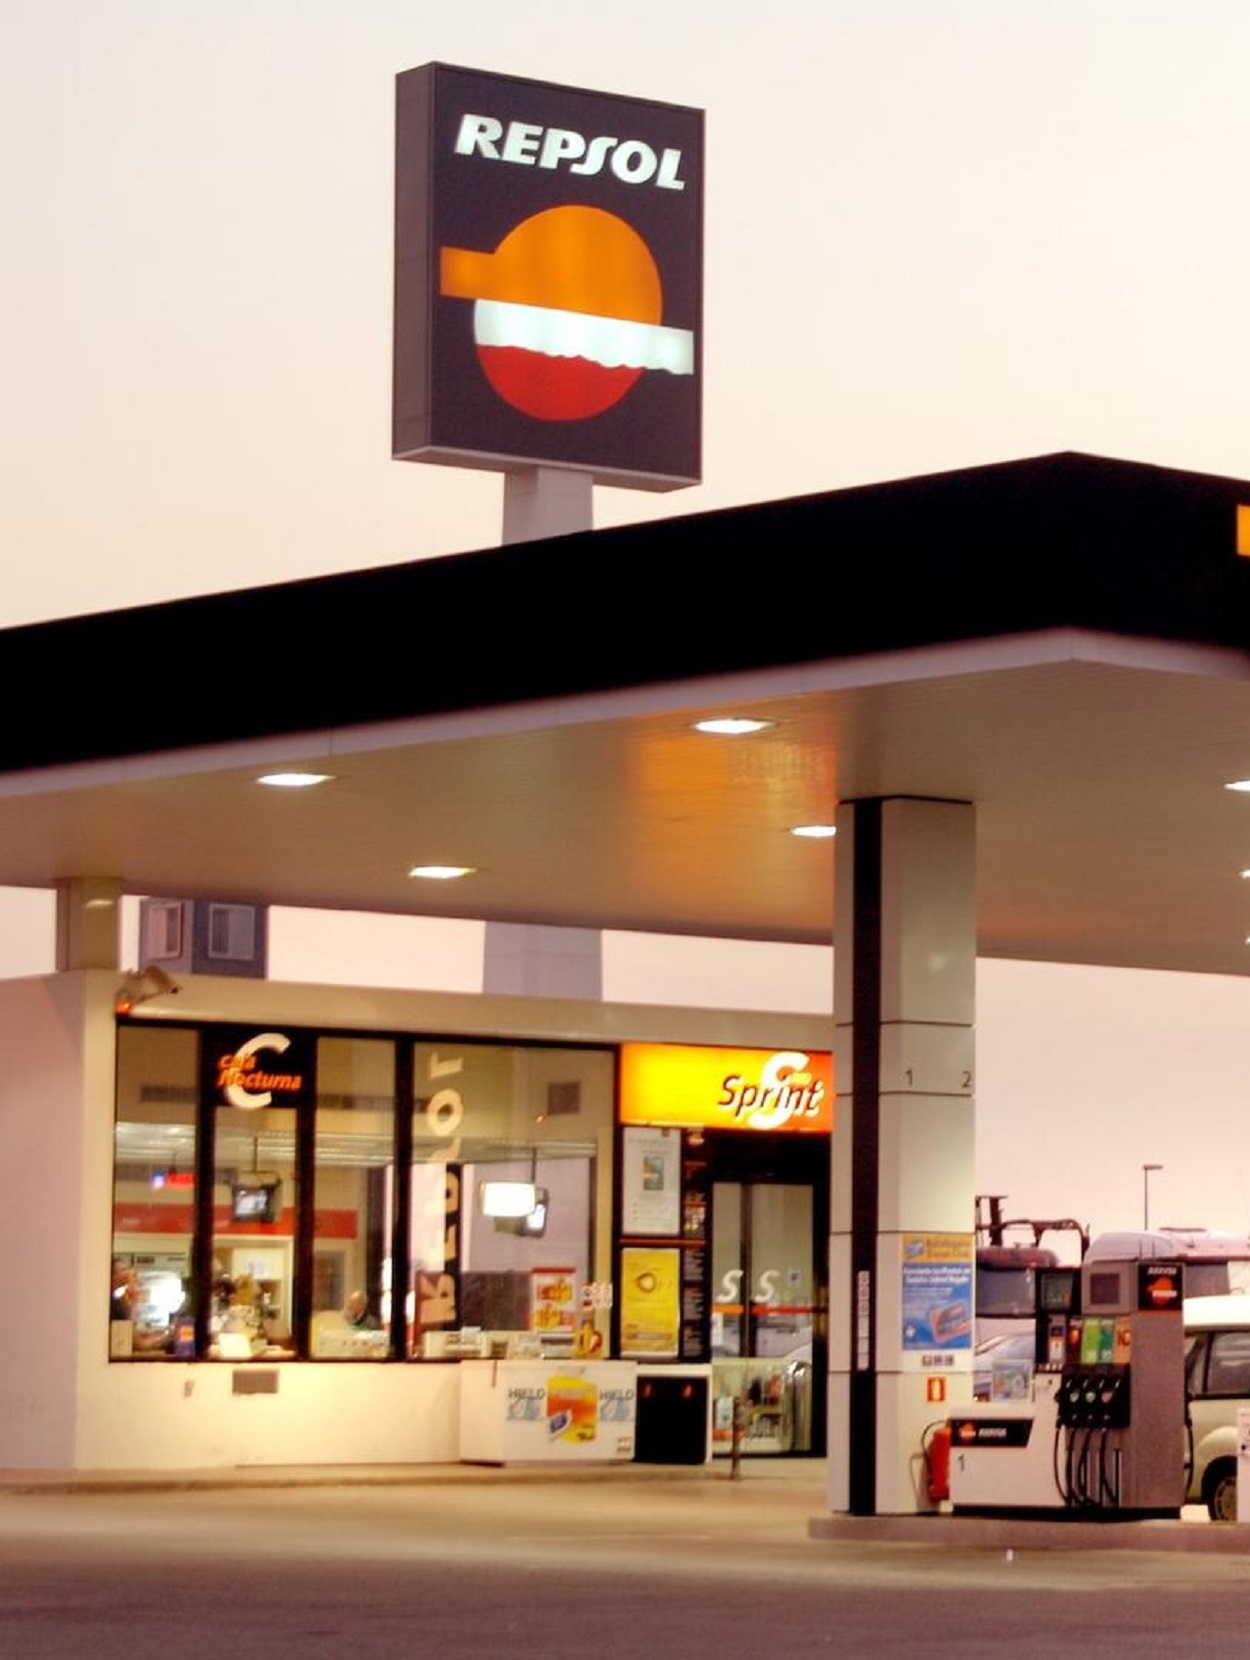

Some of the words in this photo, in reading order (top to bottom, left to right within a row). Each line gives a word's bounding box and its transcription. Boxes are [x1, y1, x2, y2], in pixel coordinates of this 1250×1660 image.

[454, 113, 685, 190] REPSOL
[905, 1069, 913, 1086] 1
[961, 1070, 971, 1088] 2
[717, 1074, 824, 1119] Sprint
[716, 1268, 744, 1302] S
[754, 1269, 781, 1302] S
[957, 1453, 965, 1472] 1
